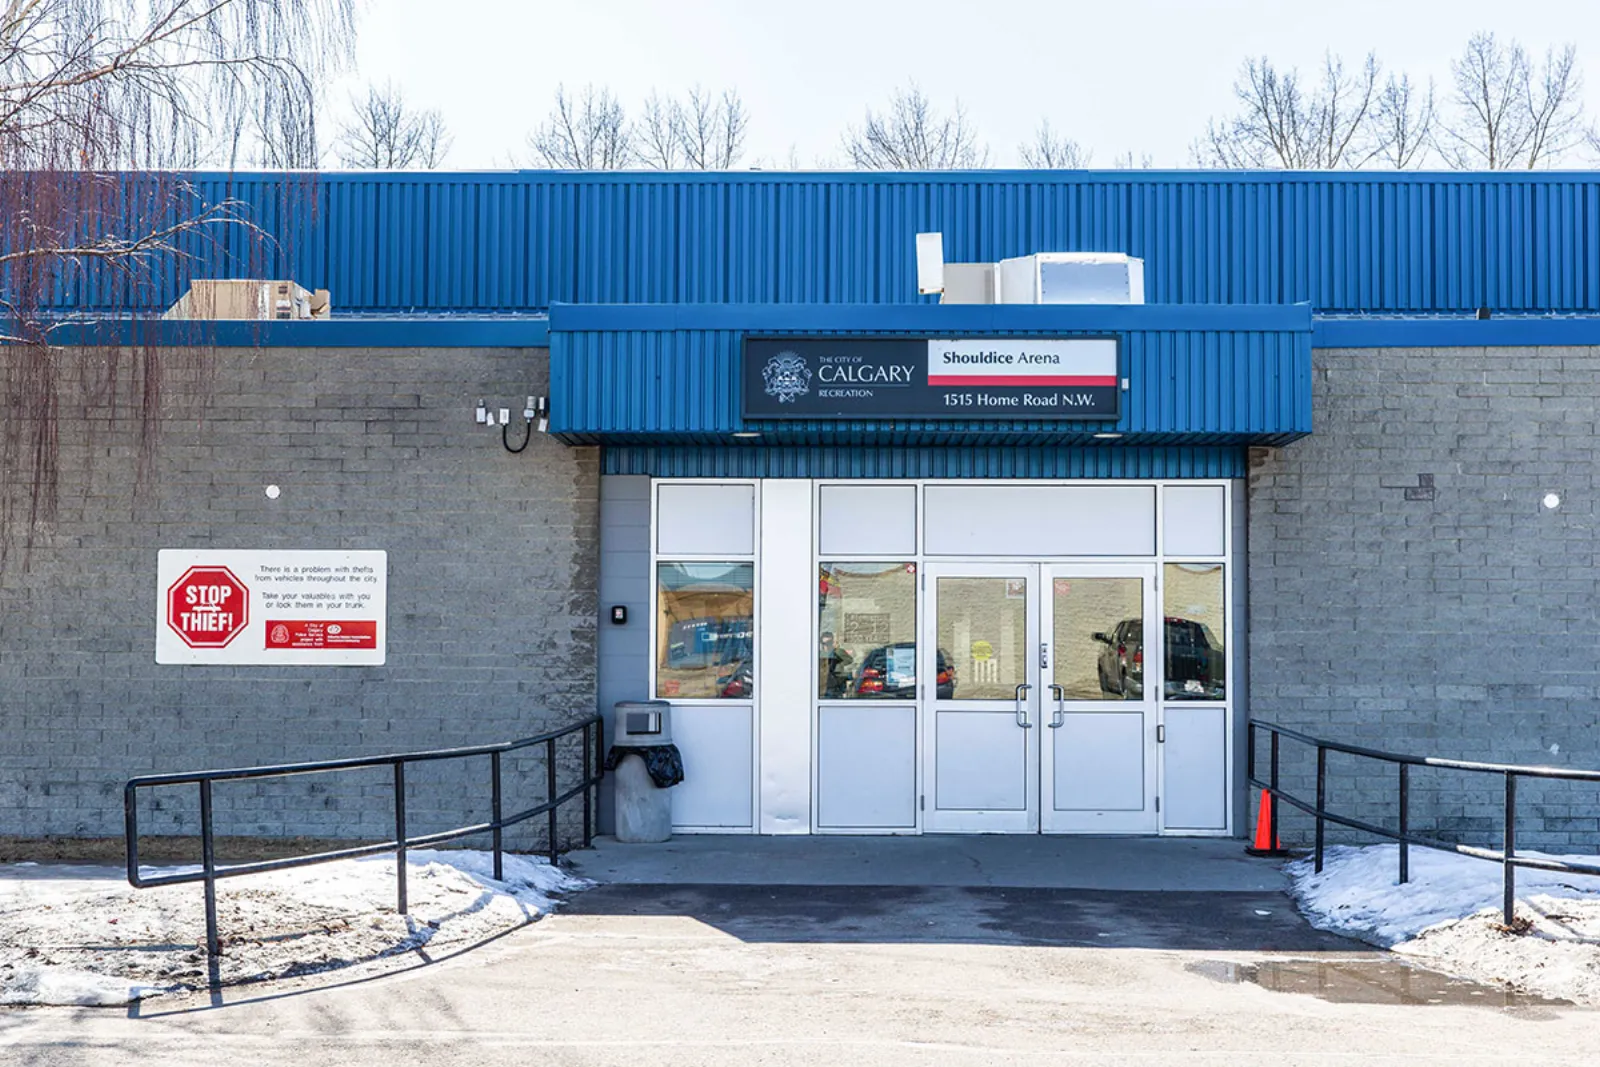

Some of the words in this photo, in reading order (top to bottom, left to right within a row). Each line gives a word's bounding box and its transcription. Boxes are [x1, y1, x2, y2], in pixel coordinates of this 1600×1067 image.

[943, 351, 1013, 364] Shouldice
[1017, 352, 1060, 364] Arena
[818, 365, 915, 382] CALGARY
[818, 389, 873, 397] RECREATION
[943, 394, 972, 406] 1515
[977, 393, 1019, 406] Home
[1023, 393, 1058, 406] Road
[1062, 394, 1095, 406] N.W.
[307, 574, 346, 583] throughout
[185, 585, 232, 604] STOP
[357, 593, 371, 602] you
[326, 602, 342, 610] your
[180, 612, 233, 631] THIEF!
